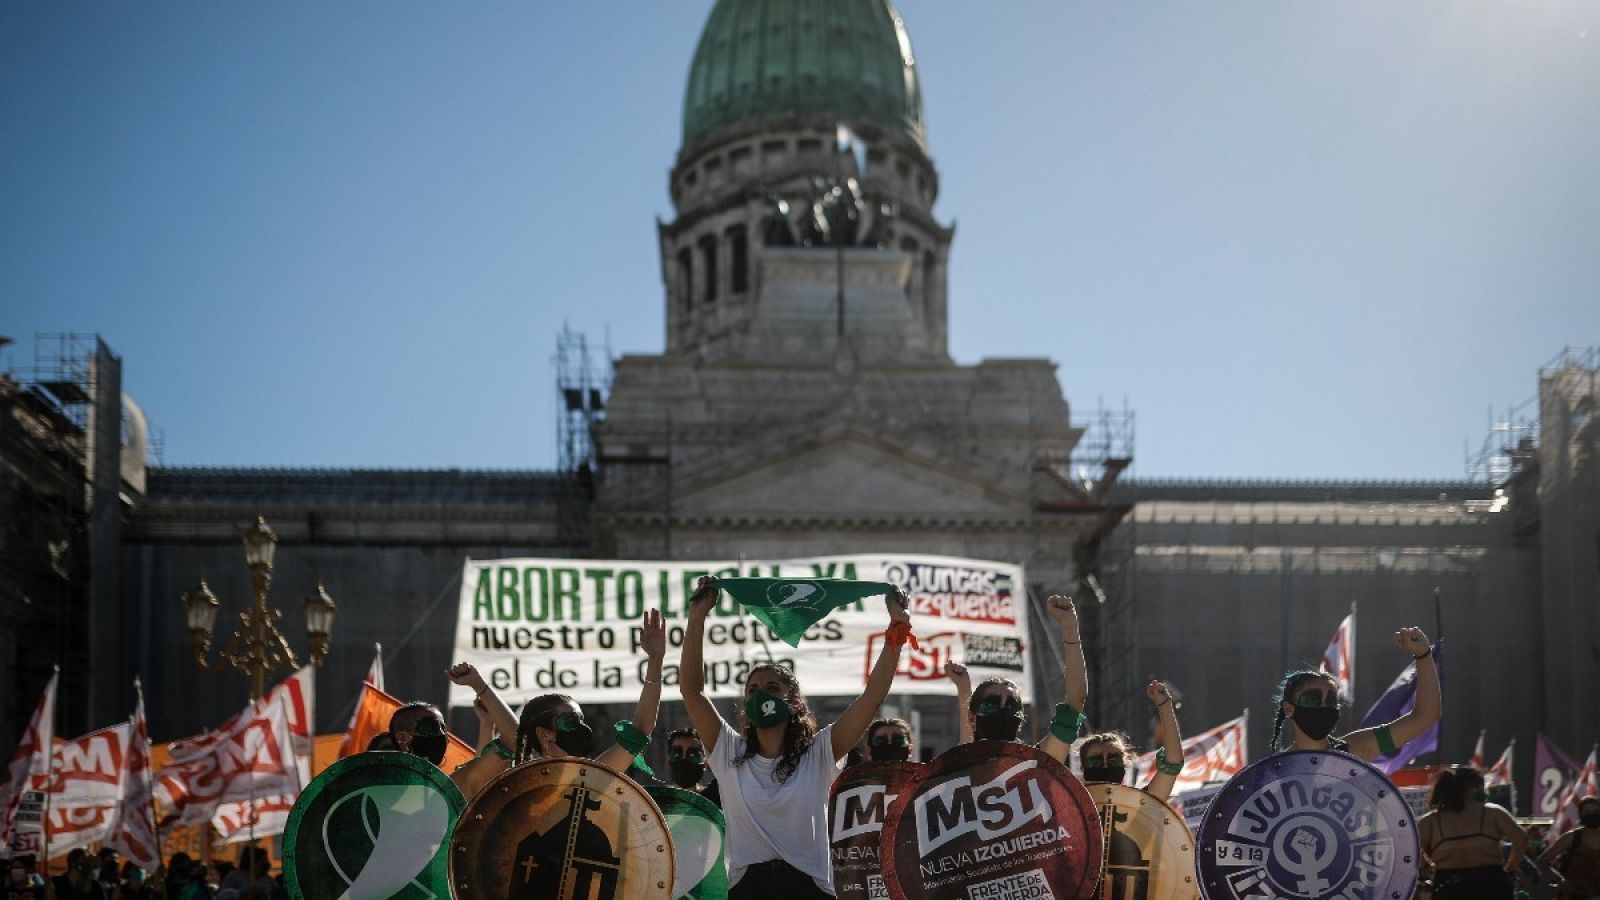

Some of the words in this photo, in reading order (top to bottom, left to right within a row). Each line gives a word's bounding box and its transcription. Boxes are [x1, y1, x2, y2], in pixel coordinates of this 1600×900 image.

[473, 567, 643, 621] ABORTO
[472, 624, 615, 650] nuestro
[491, 658, 521, 690] el
[593, 659, 623, 689] la
[922, 763, 1043, 848] MST
[831, 846, 876, 861] NUEVA
[919, 851, 973, 878] NUEVA
[973, 825, 1071, 863] IZQUIERDA
[1218, 847, 1228, 859] y
[1232, 847, 1243, 860] a
[971, 875, 1027, 897] FRENTE
[1026, 873, 1042, 885] DE
